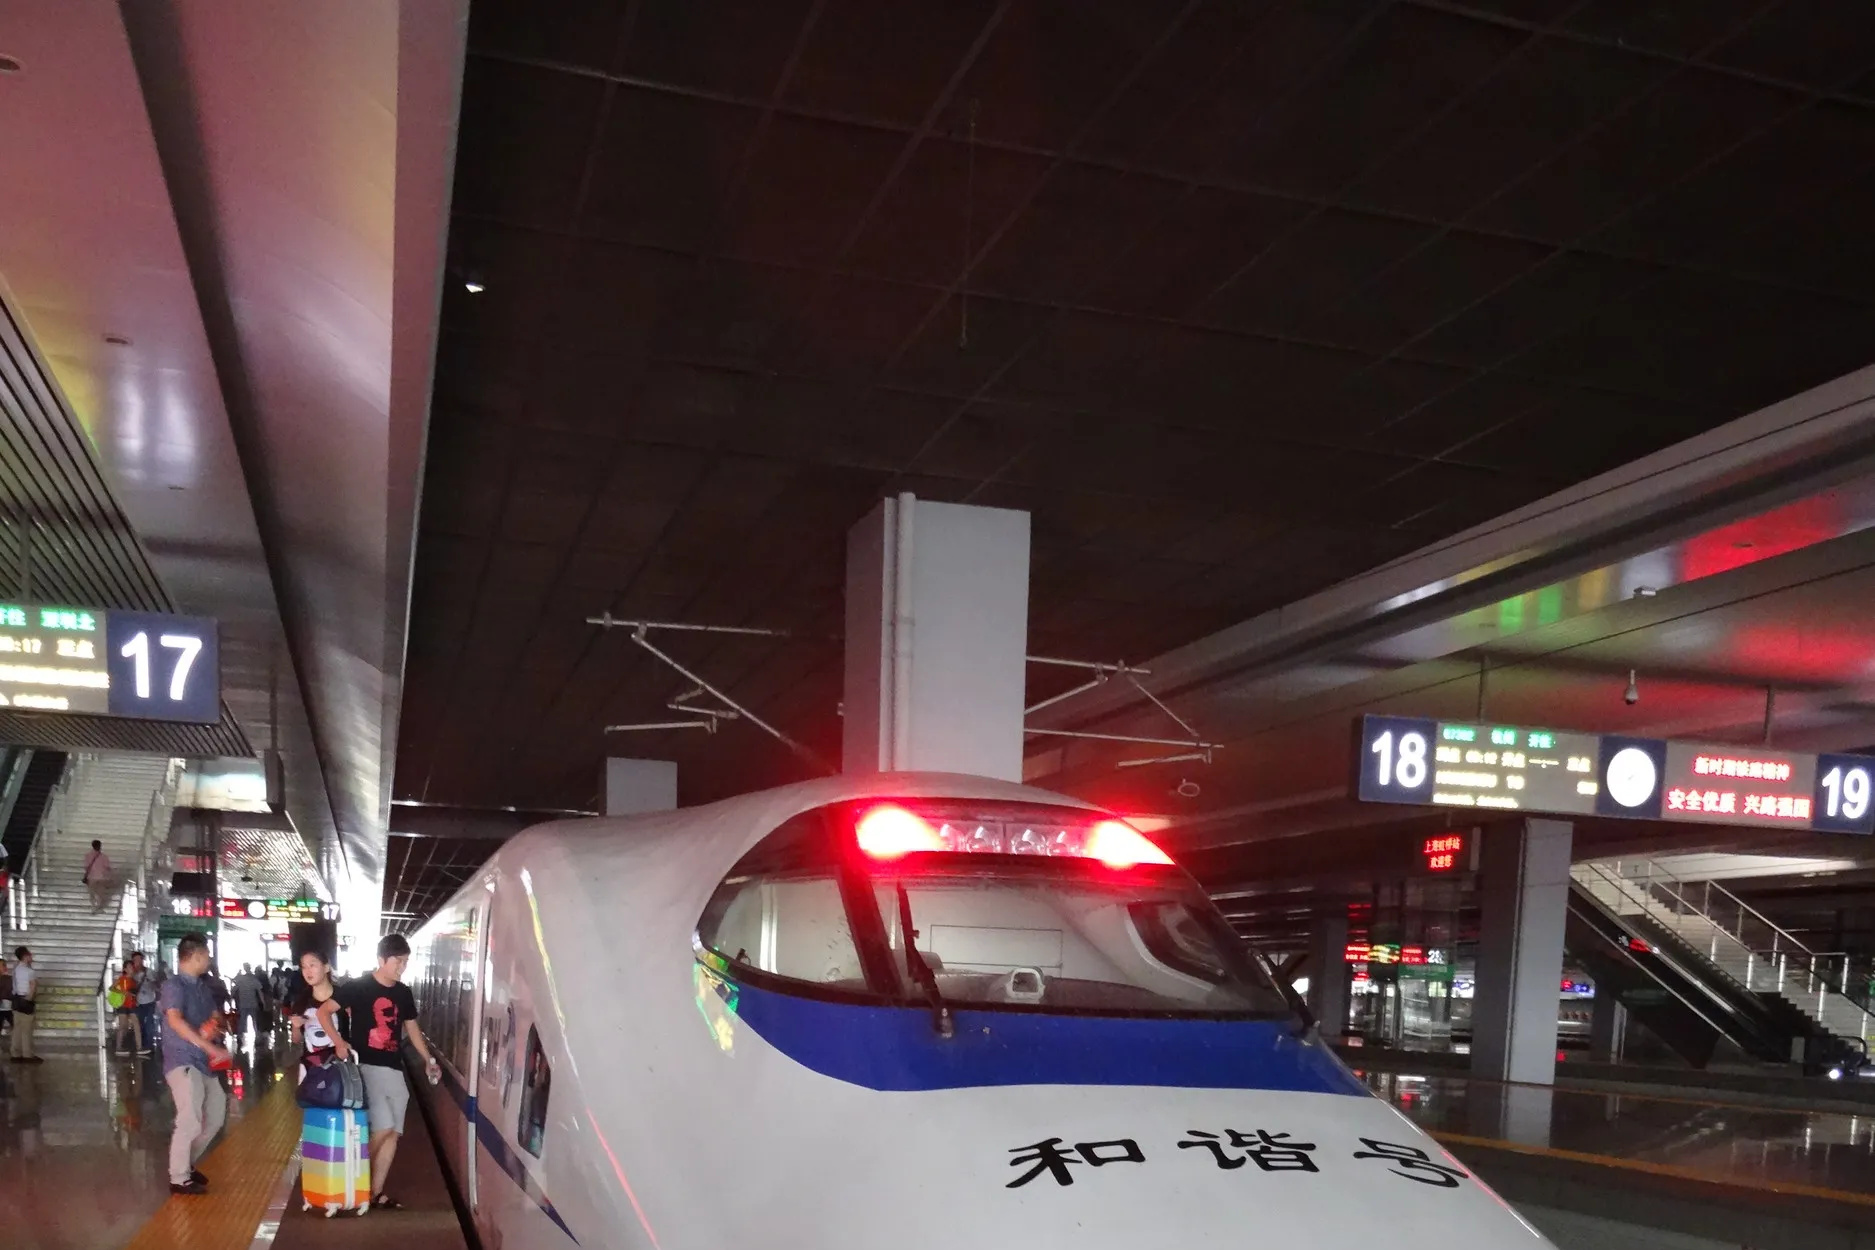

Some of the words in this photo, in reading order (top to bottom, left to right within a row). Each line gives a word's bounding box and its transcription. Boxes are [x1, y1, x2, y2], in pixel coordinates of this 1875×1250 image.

[121, 631, 202, 701] 17
[1372, 731, 1426, 788] 18
[1668, 788, 1735, 814] 安全优质
[1743, 794, 1810, 819] 兴路强国
[1822, 766, 1870, 819] 19
[1423, 837, 1461, 853] 上海虹桥站
[171, 899, 191, 915] 16
[321, 904, 340, 920] 17
[1005, 1128, 1469, 1189] 和谐号
